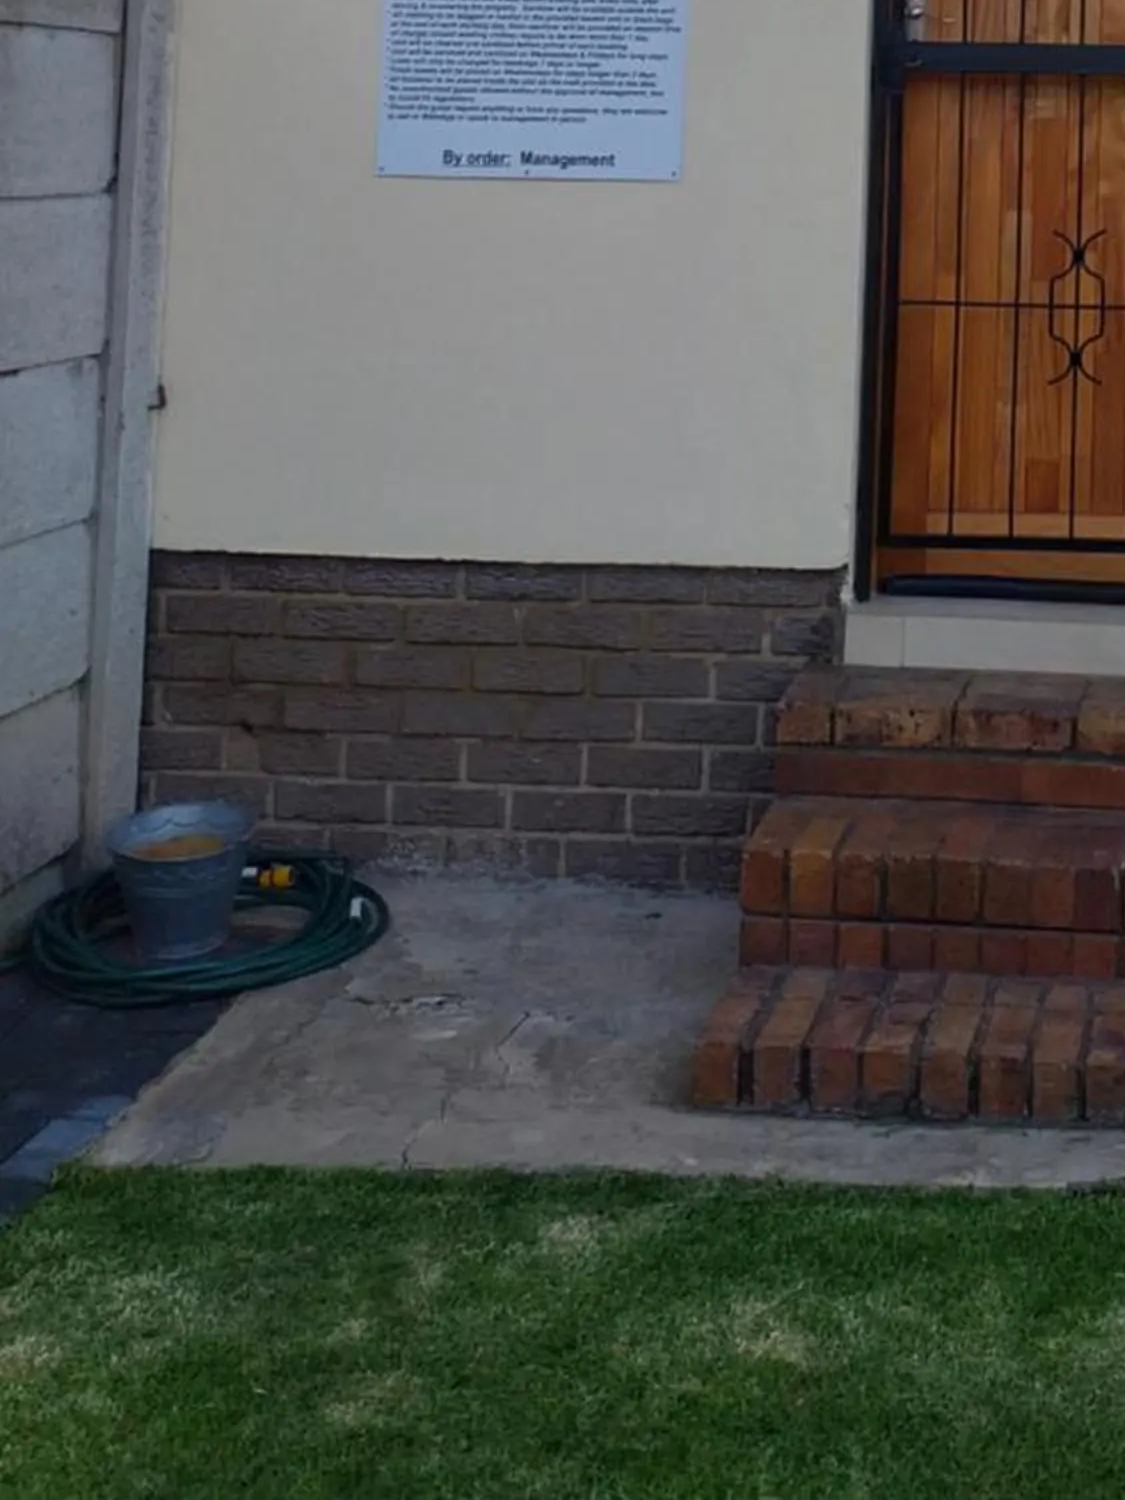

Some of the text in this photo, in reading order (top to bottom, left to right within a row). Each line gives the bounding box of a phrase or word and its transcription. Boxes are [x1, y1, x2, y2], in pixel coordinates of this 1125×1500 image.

[442, 149, 616, 169] By order: Management
